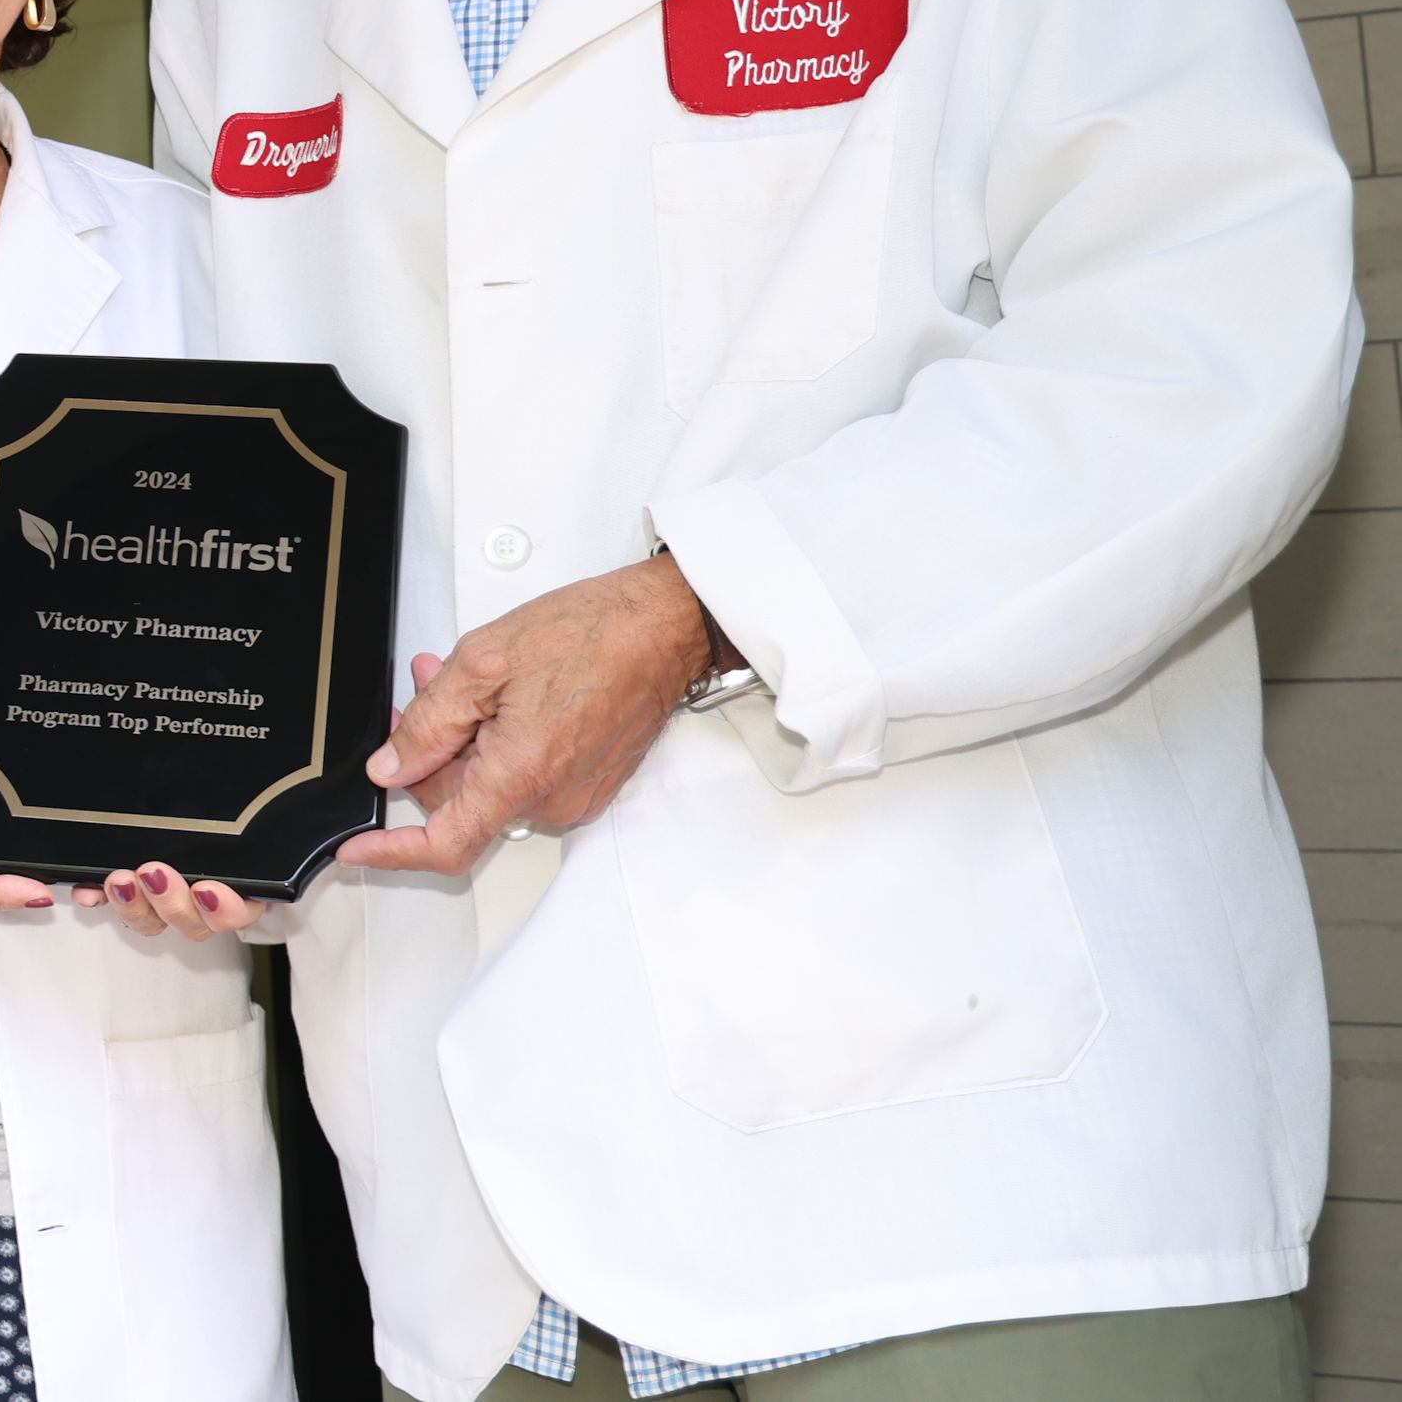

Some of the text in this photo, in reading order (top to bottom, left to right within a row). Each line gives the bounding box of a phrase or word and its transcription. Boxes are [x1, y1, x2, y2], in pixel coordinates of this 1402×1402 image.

[724, 49, 870, 87] Pharmacy
[133, 470, 193, 491] 2024
[62, 520, 294, 574] healthfirst
[35, 610, 263, 648] Victory Pharmacy
[18, 673, 265, 709] Pharmacy Partnership
[5, 704, 270, 740] Program Top Performer
